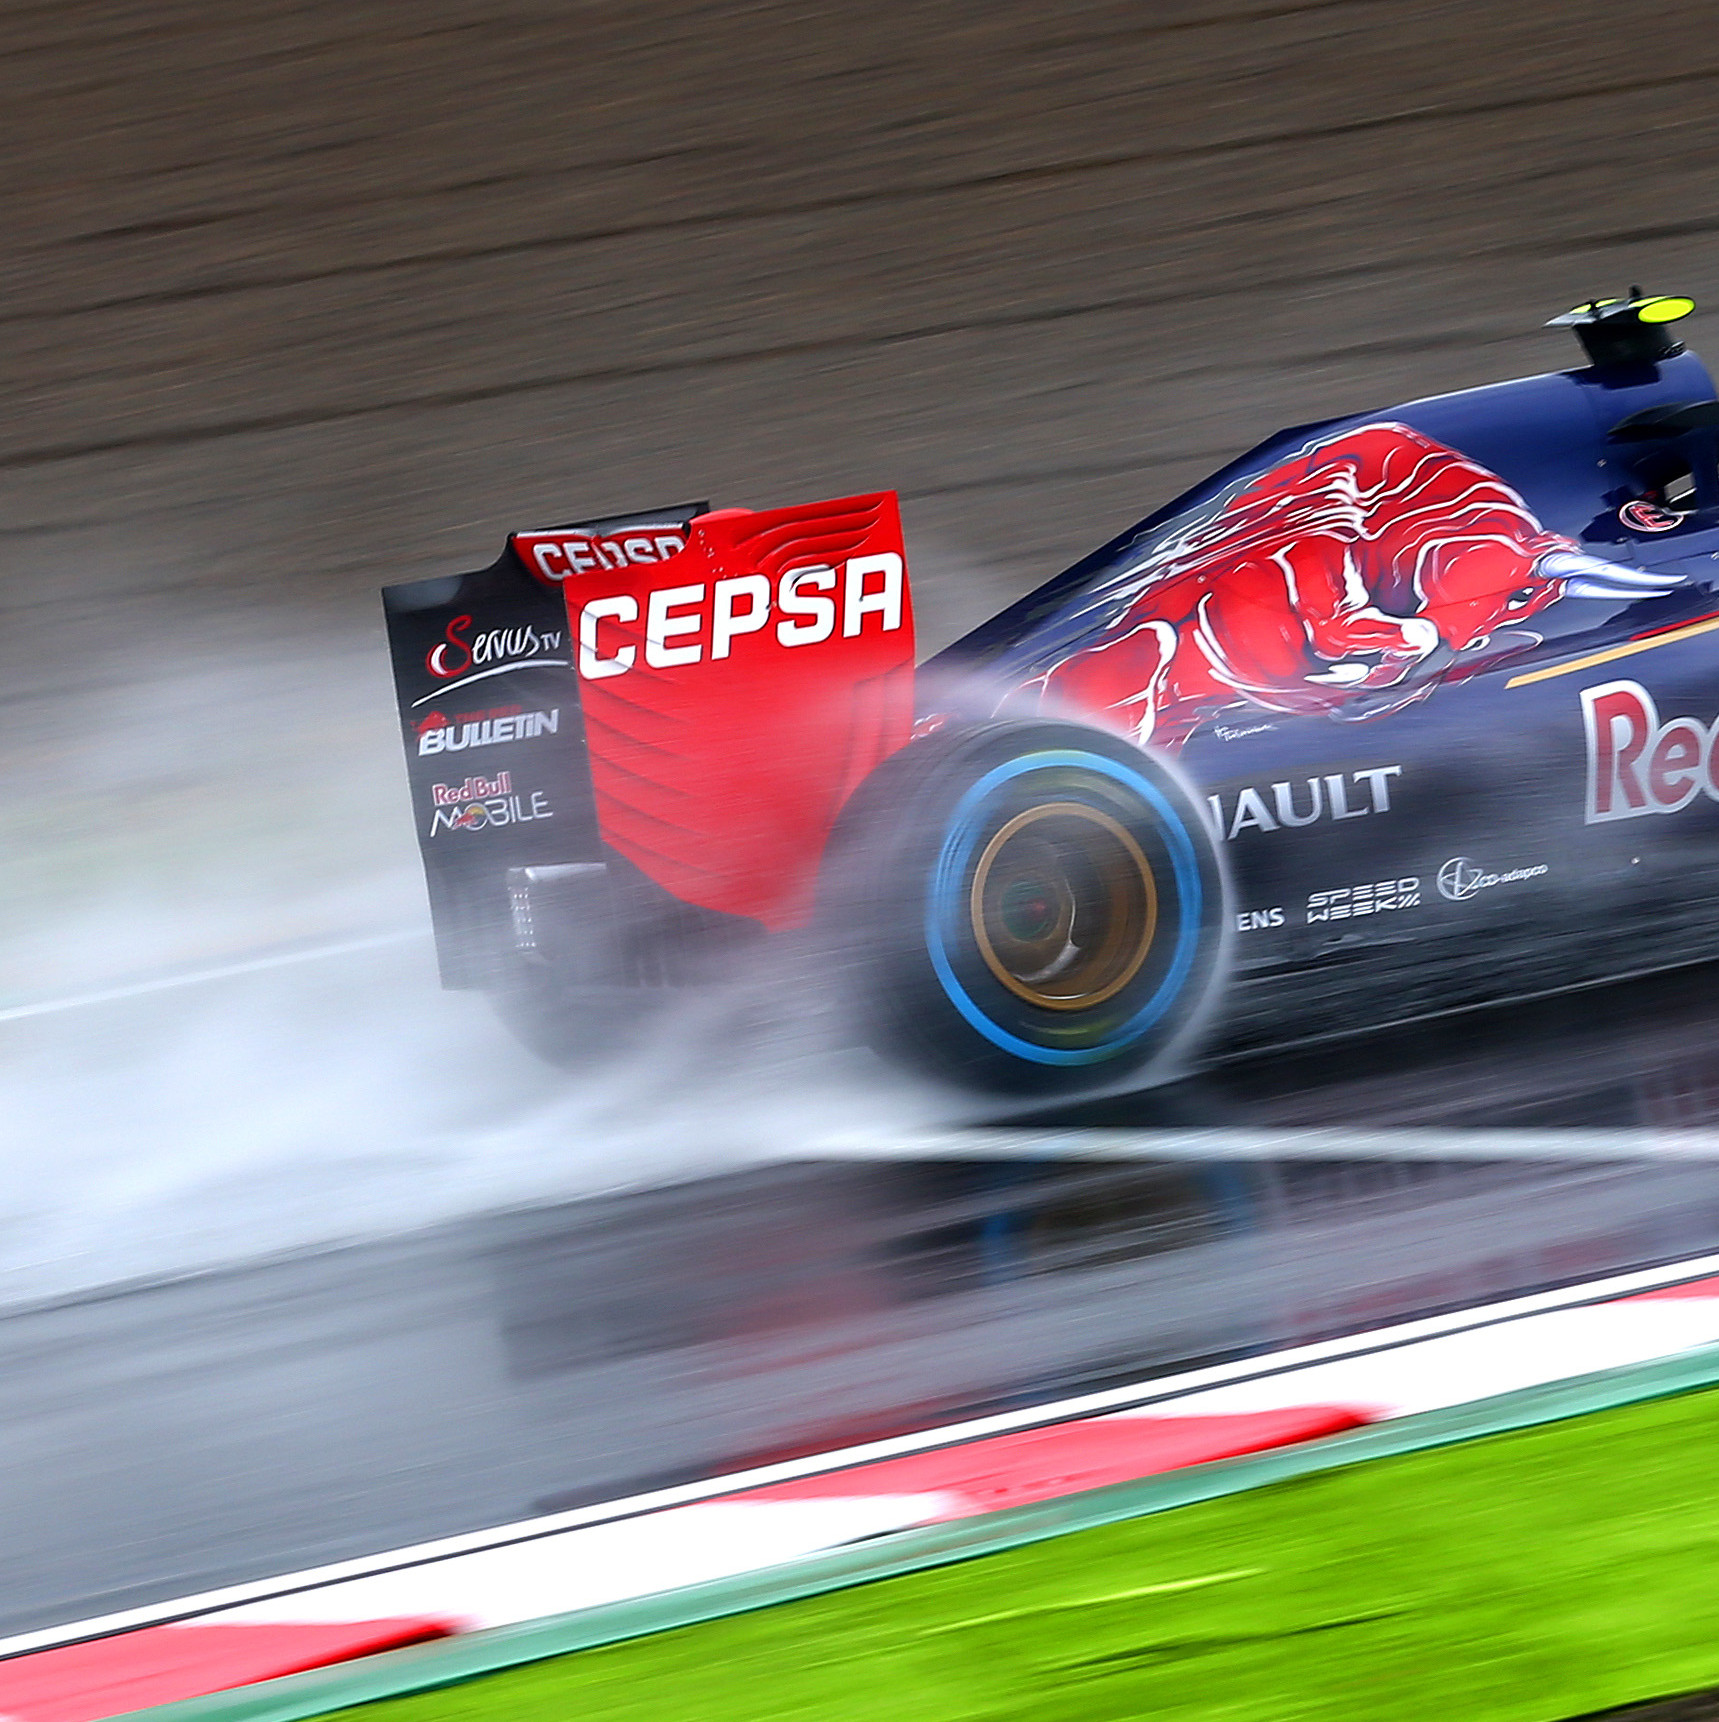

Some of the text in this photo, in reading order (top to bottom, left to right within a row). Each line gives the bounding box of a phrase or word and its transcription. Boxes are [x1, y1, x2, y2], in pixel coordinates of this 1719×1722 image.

[579, 552, 903, 681] CEPSA
[432, 771, 513, 806] Red Bull
[430, 791, 554, 837] MOBILE
[1306, 876, 1420, 908] SPEED
[1307, 896, 1398, 924] WEEK
